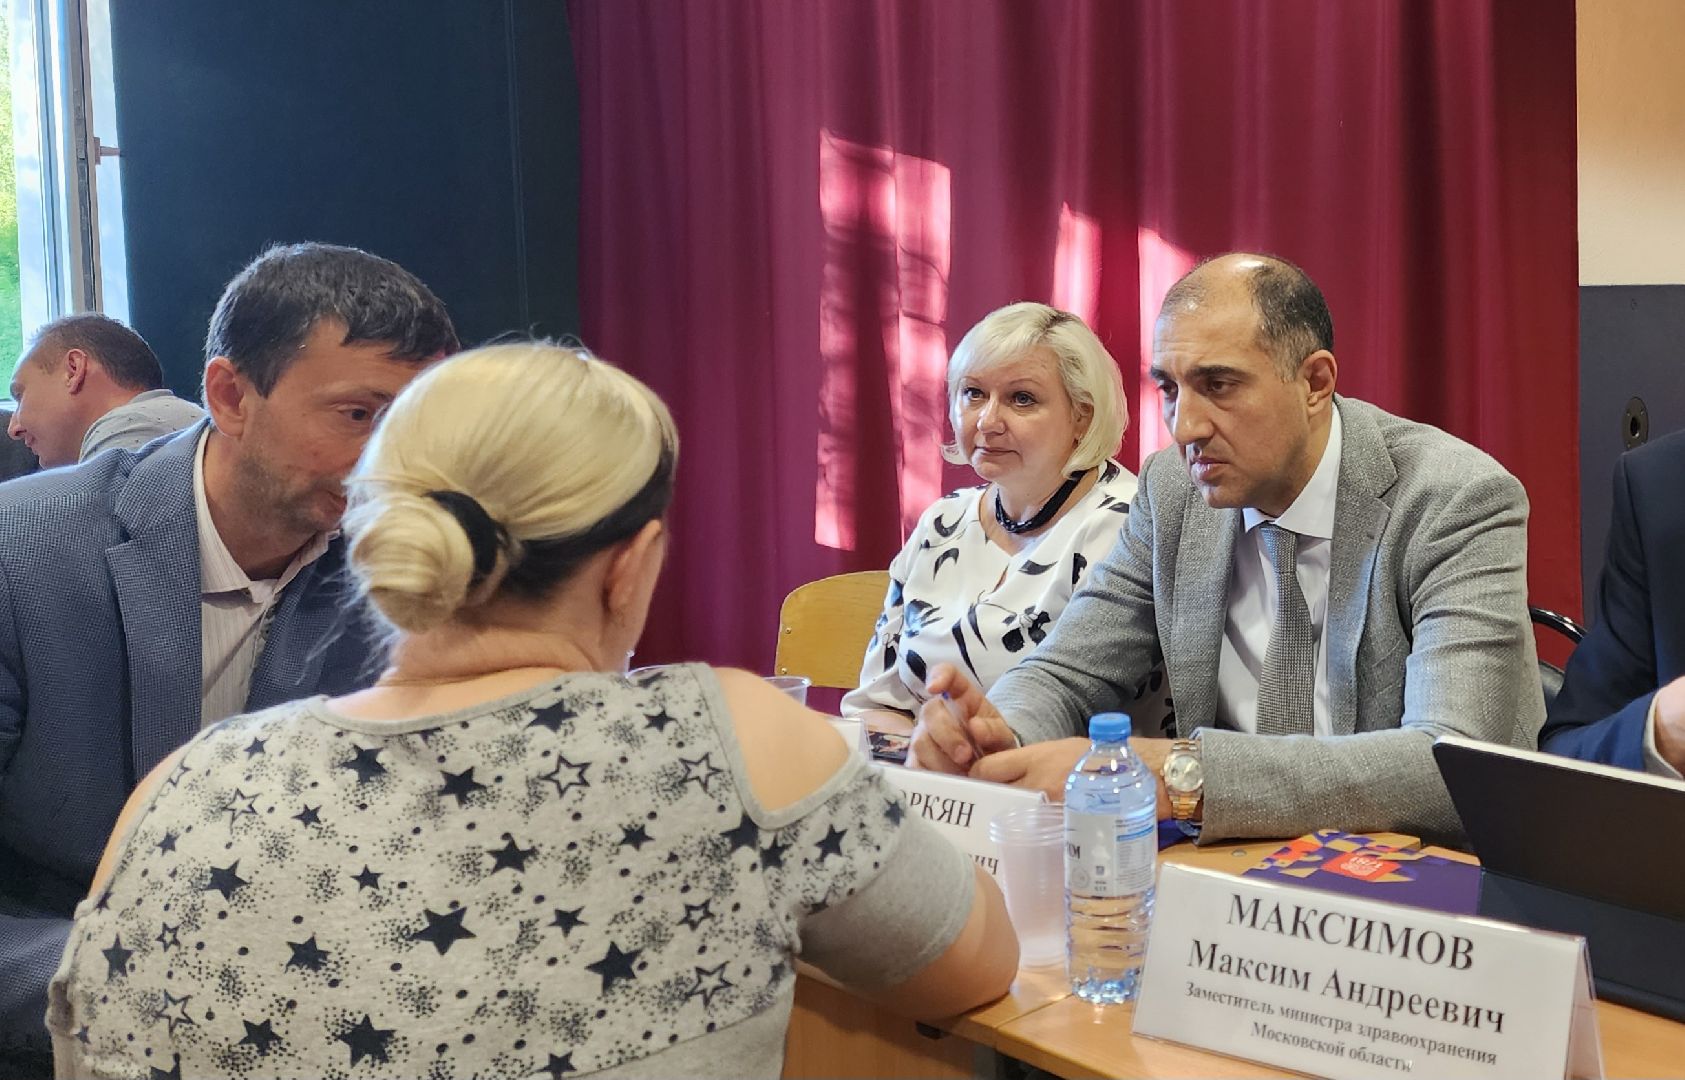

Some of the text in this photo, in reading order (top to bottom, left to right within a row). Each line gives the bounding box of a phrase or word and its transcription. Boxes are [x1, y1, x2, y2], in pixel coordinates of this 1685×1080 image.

[1226, 893, 1474, 970] МАКСИМОВ
[1185, 981, 1498, 1065] Заместитель министра здравоохранения
[1186, 938, 1505, 1034] Максим Андреевич
[1250, 1021, 1413, 1073] Московской области
